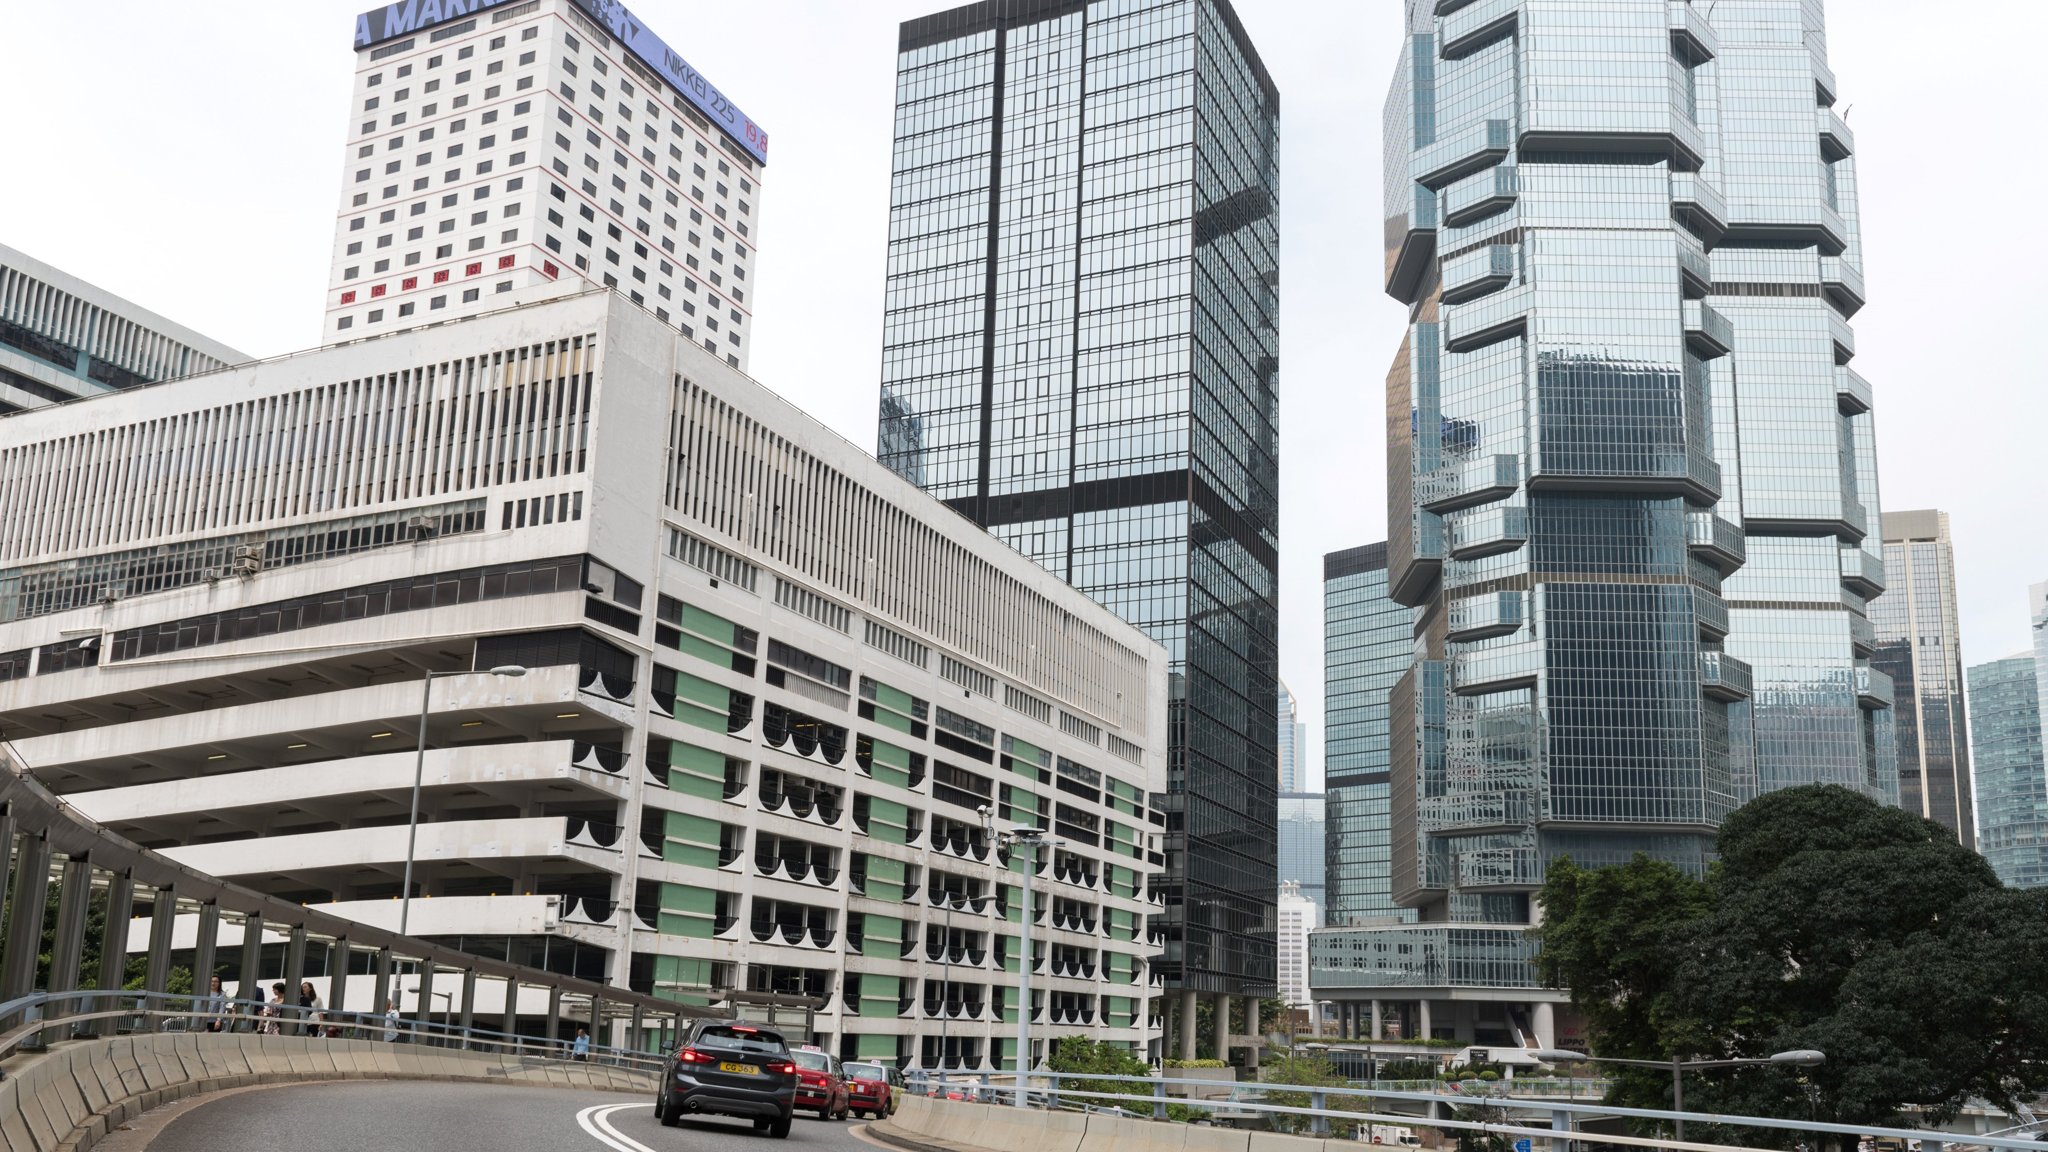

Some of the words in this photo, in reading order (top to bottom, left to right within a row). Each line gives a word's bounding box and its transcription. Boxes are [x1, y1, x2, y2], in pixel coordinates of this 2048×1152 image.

[664, 48, 706, 100] NIKKEI
[710, 90, 735, 124] 225
[1558, 1038, 1585, 1046] LIPPO
